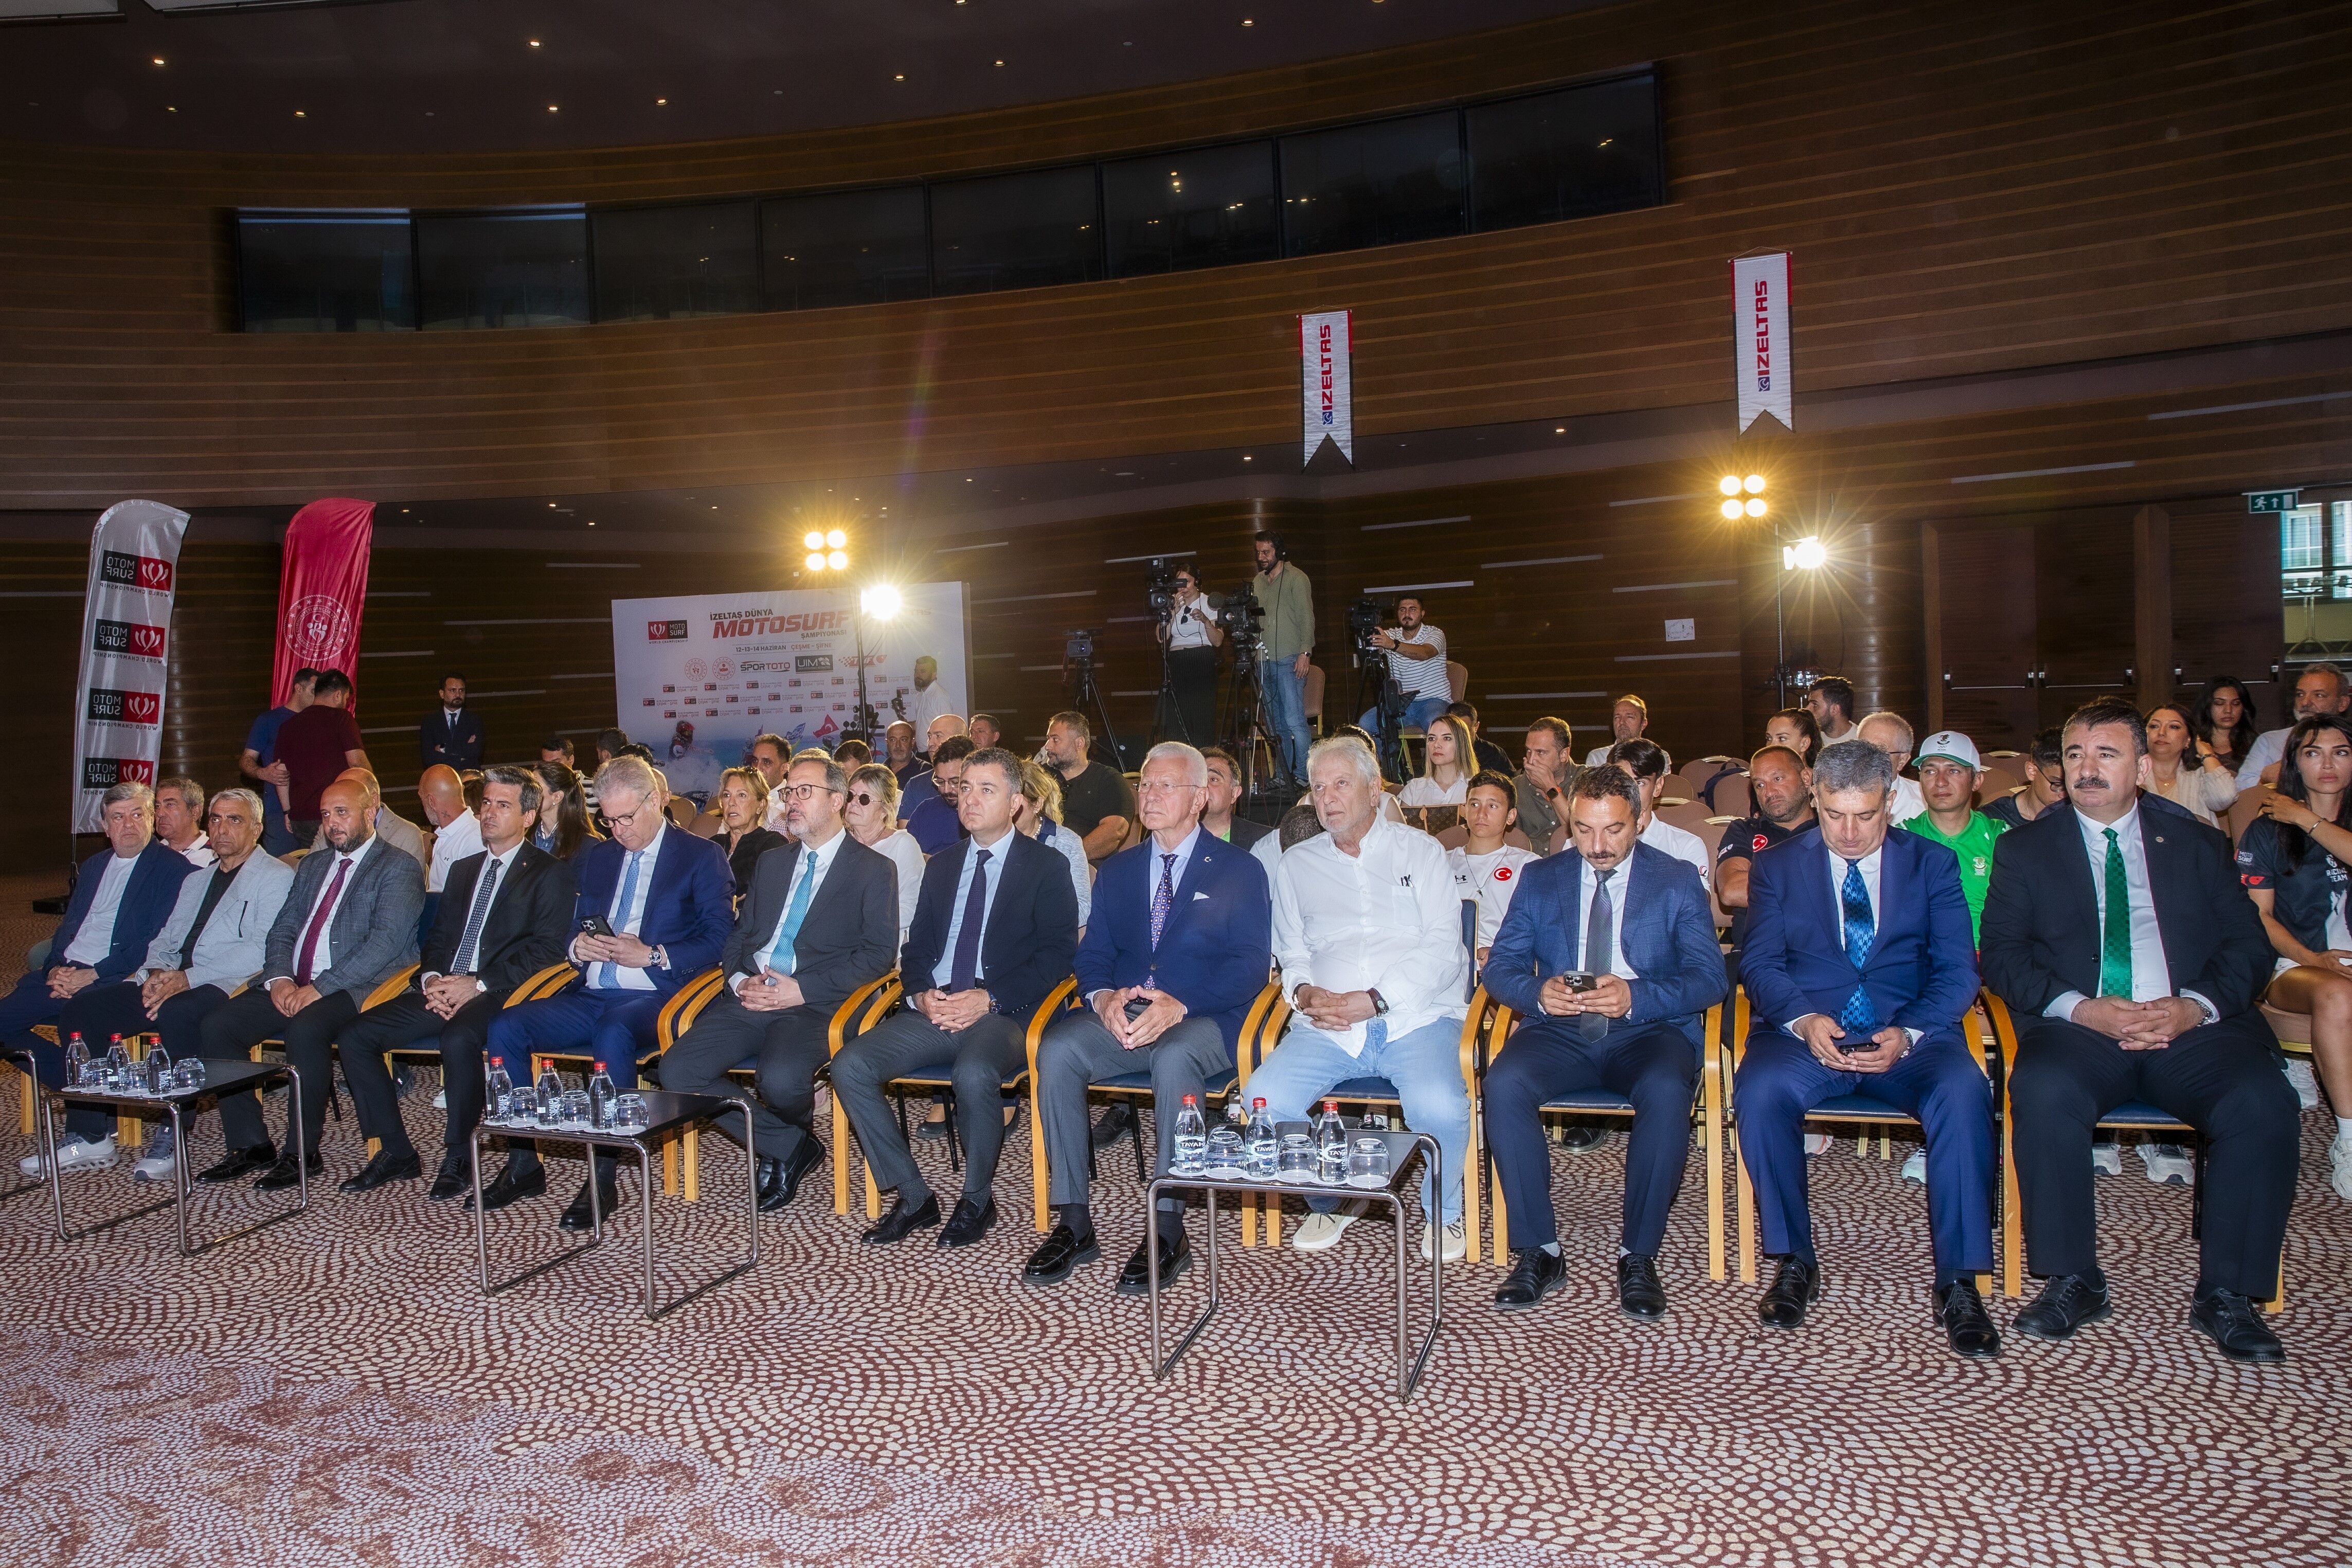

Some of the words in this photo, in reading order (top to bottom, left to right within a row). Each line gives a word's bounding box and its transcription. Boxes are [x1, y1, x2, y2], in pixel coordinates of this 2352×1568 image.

[710, 611, 743, 620] İZELTAŞ
[745, 608, 774, 617] DÜNYA
[713, 610, 851, 639] MOTOSURF
[801, 629, 847, 640] ŞAMPİYONASI
[798, 658, 818, 668] UIM
